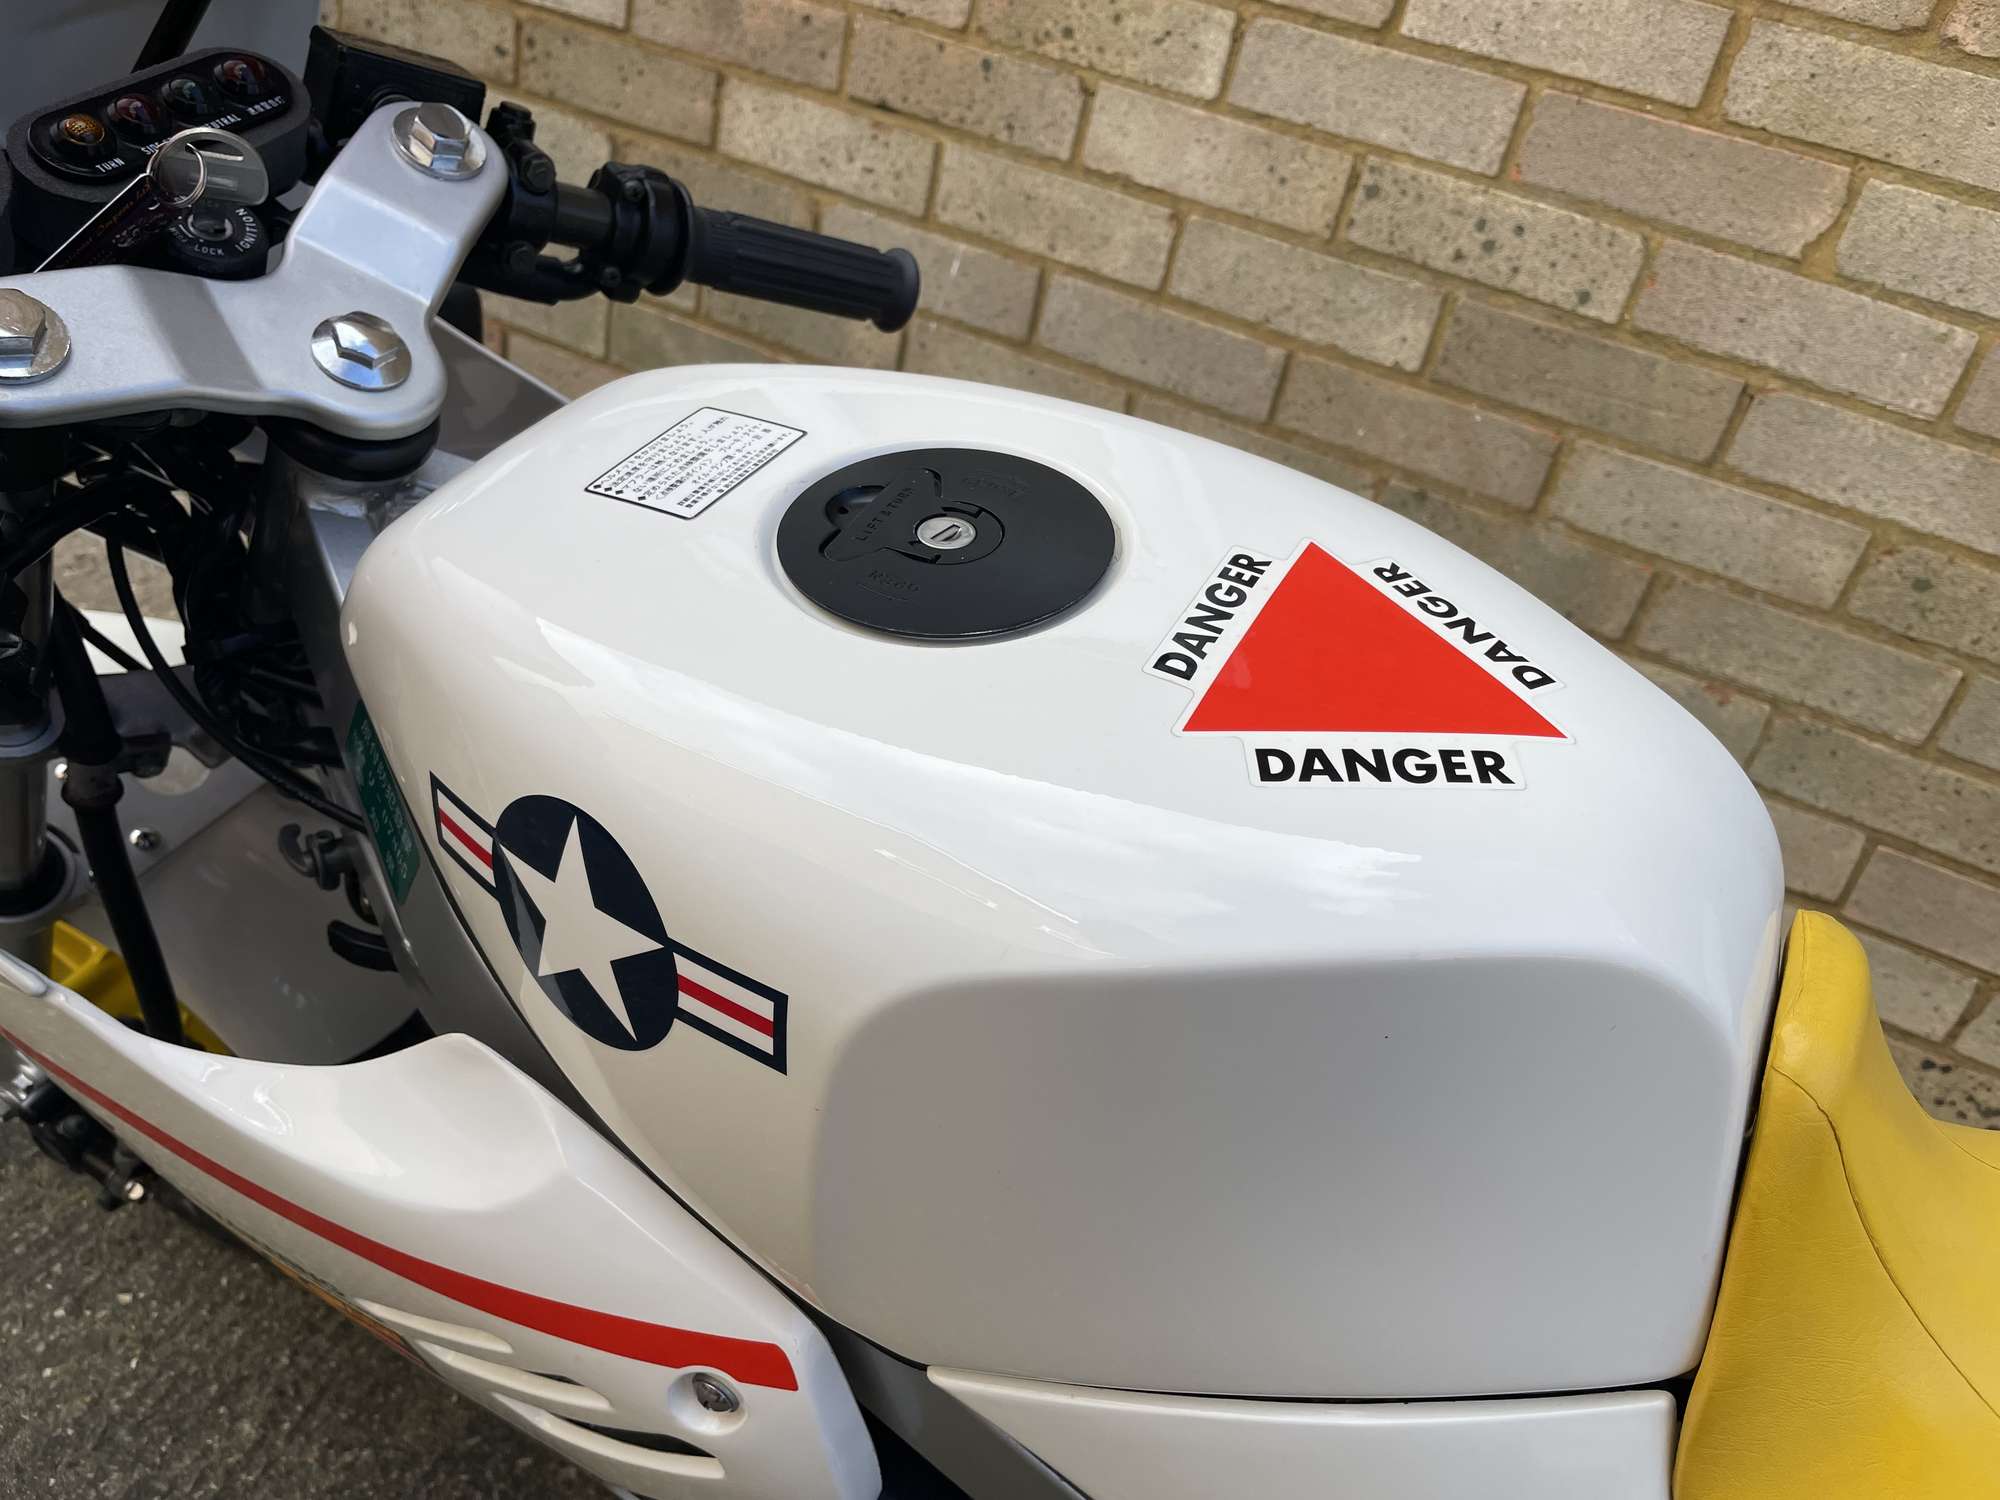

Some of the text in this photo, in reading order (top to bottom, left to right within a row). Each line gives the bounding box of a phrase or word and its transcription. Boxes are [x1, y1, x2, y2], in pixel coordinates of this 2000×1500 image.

[95, 158, 125, 173] TURN
[194, 244, 225, 256] LOCK
[235, 208, 258, 252] IGNITION
[1152, 554, 1272, 681] DANGER
[1373, 562, 1556, 689] DANGER
[1255, 748, 1515, 784] DANGER
